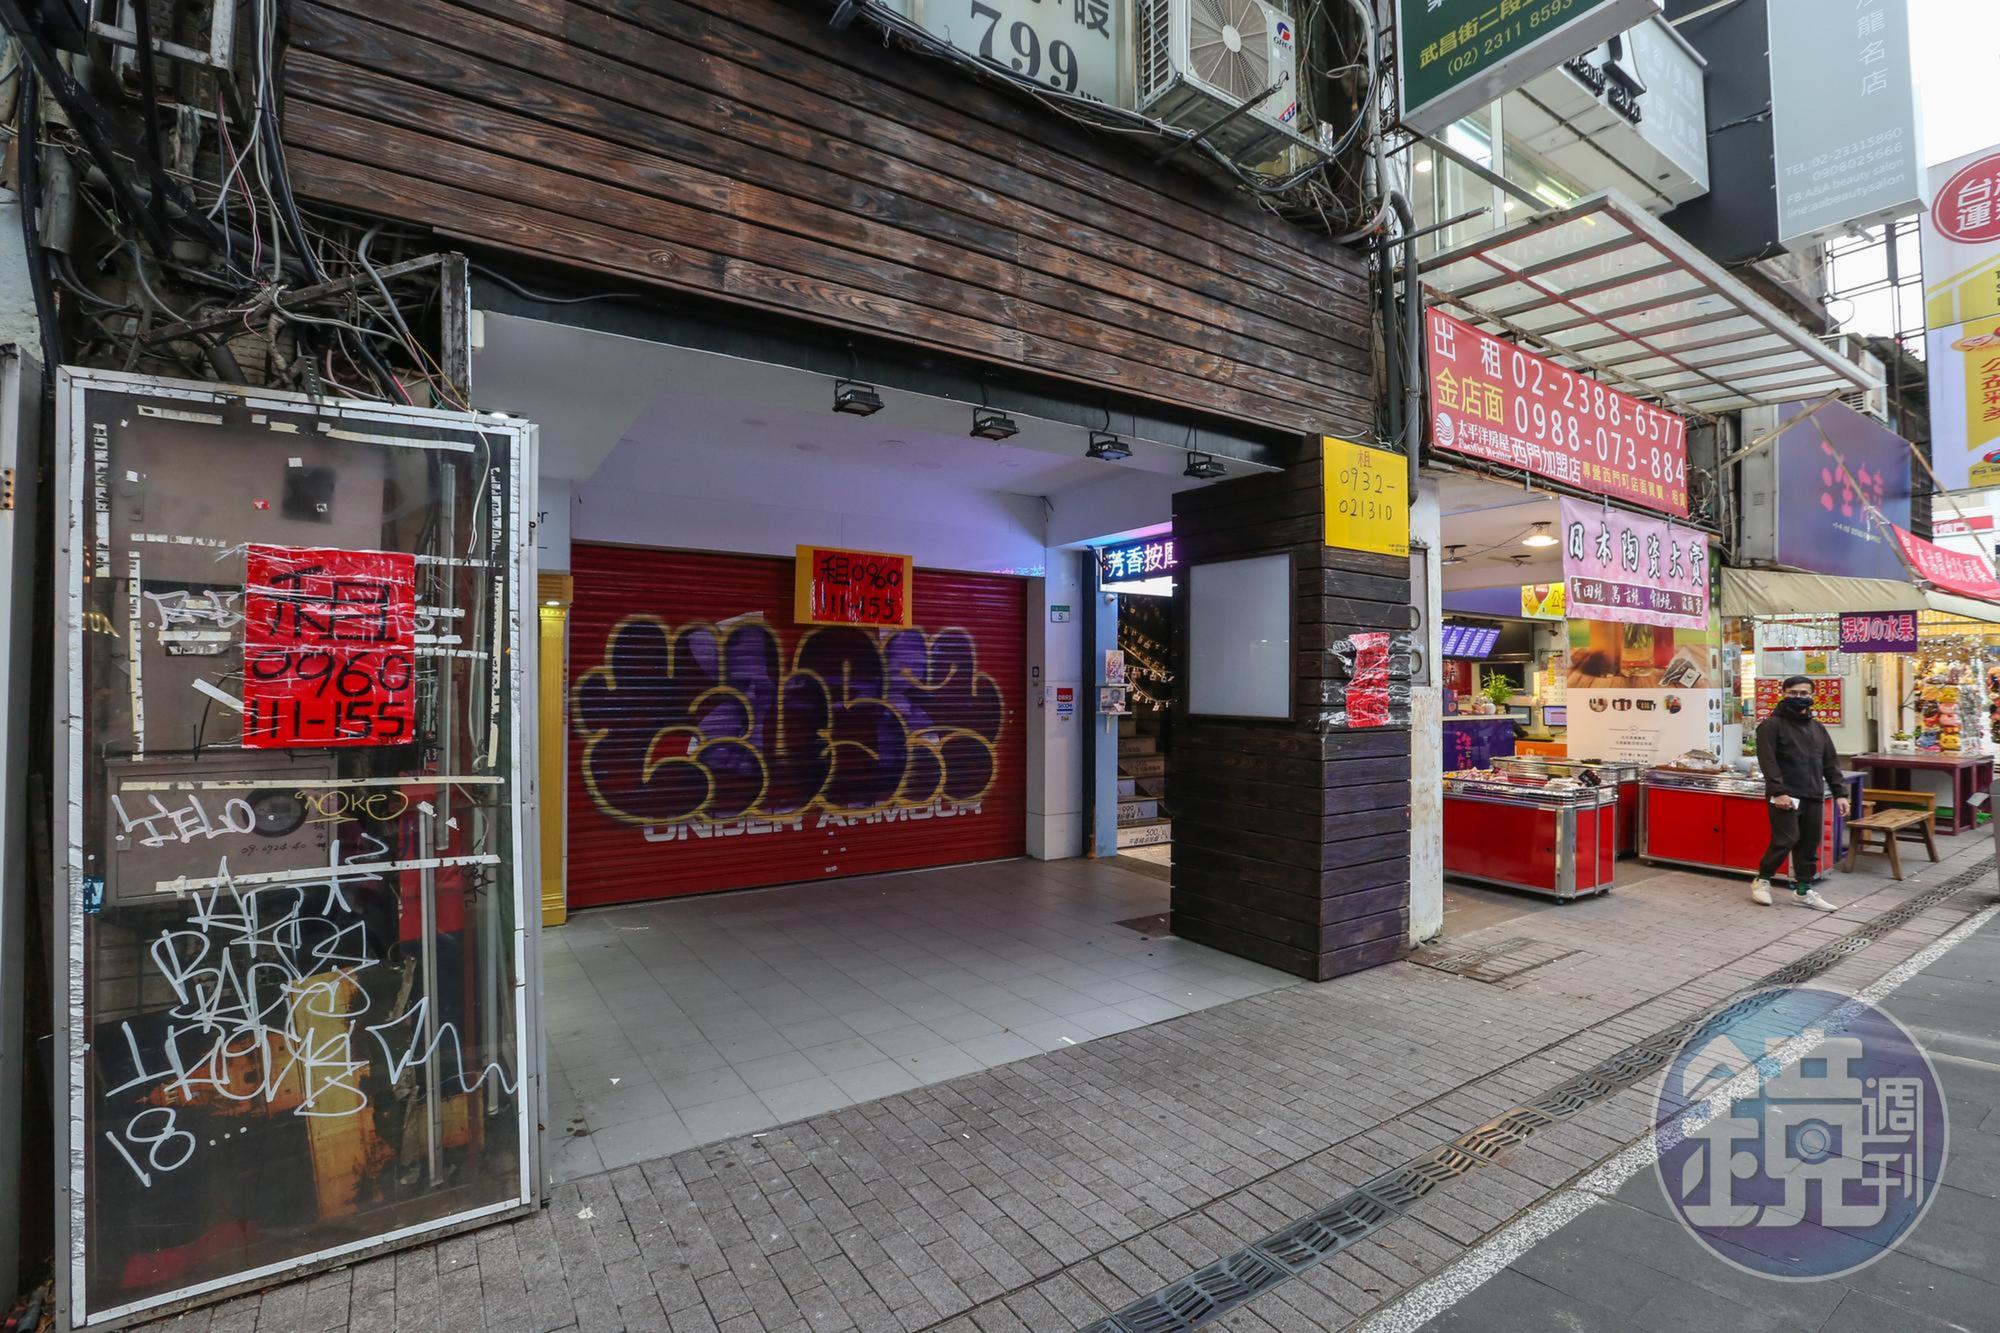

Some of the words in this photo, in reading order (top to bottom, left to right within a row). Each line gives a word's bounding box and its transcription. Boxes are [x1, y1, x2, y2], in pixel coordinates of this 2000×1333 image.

[970, 0, 1079, 94] 799
[1419, 0, 1536, 69] 武昌街二段
[1447, 47, 1479, 76] (02)
[1484, 20, 1522, 56] 2311
[1434, 317, 1503, 380] 出租
[1436, 367, 1504, 426] 金店面
[1512, 351, 1684, 449] 02-2388-6577
[1457, 419, 1511, 452] 太平洋房屋
[1510, 436, 1582, 484] 西門加盟店
[1514, 395, 1685, 488] 0988-073-884
[1339, 499, 1393, 520] 021310
[252, 651, 411, 698] 0960
[250, 700, 405, 739] 111-155
